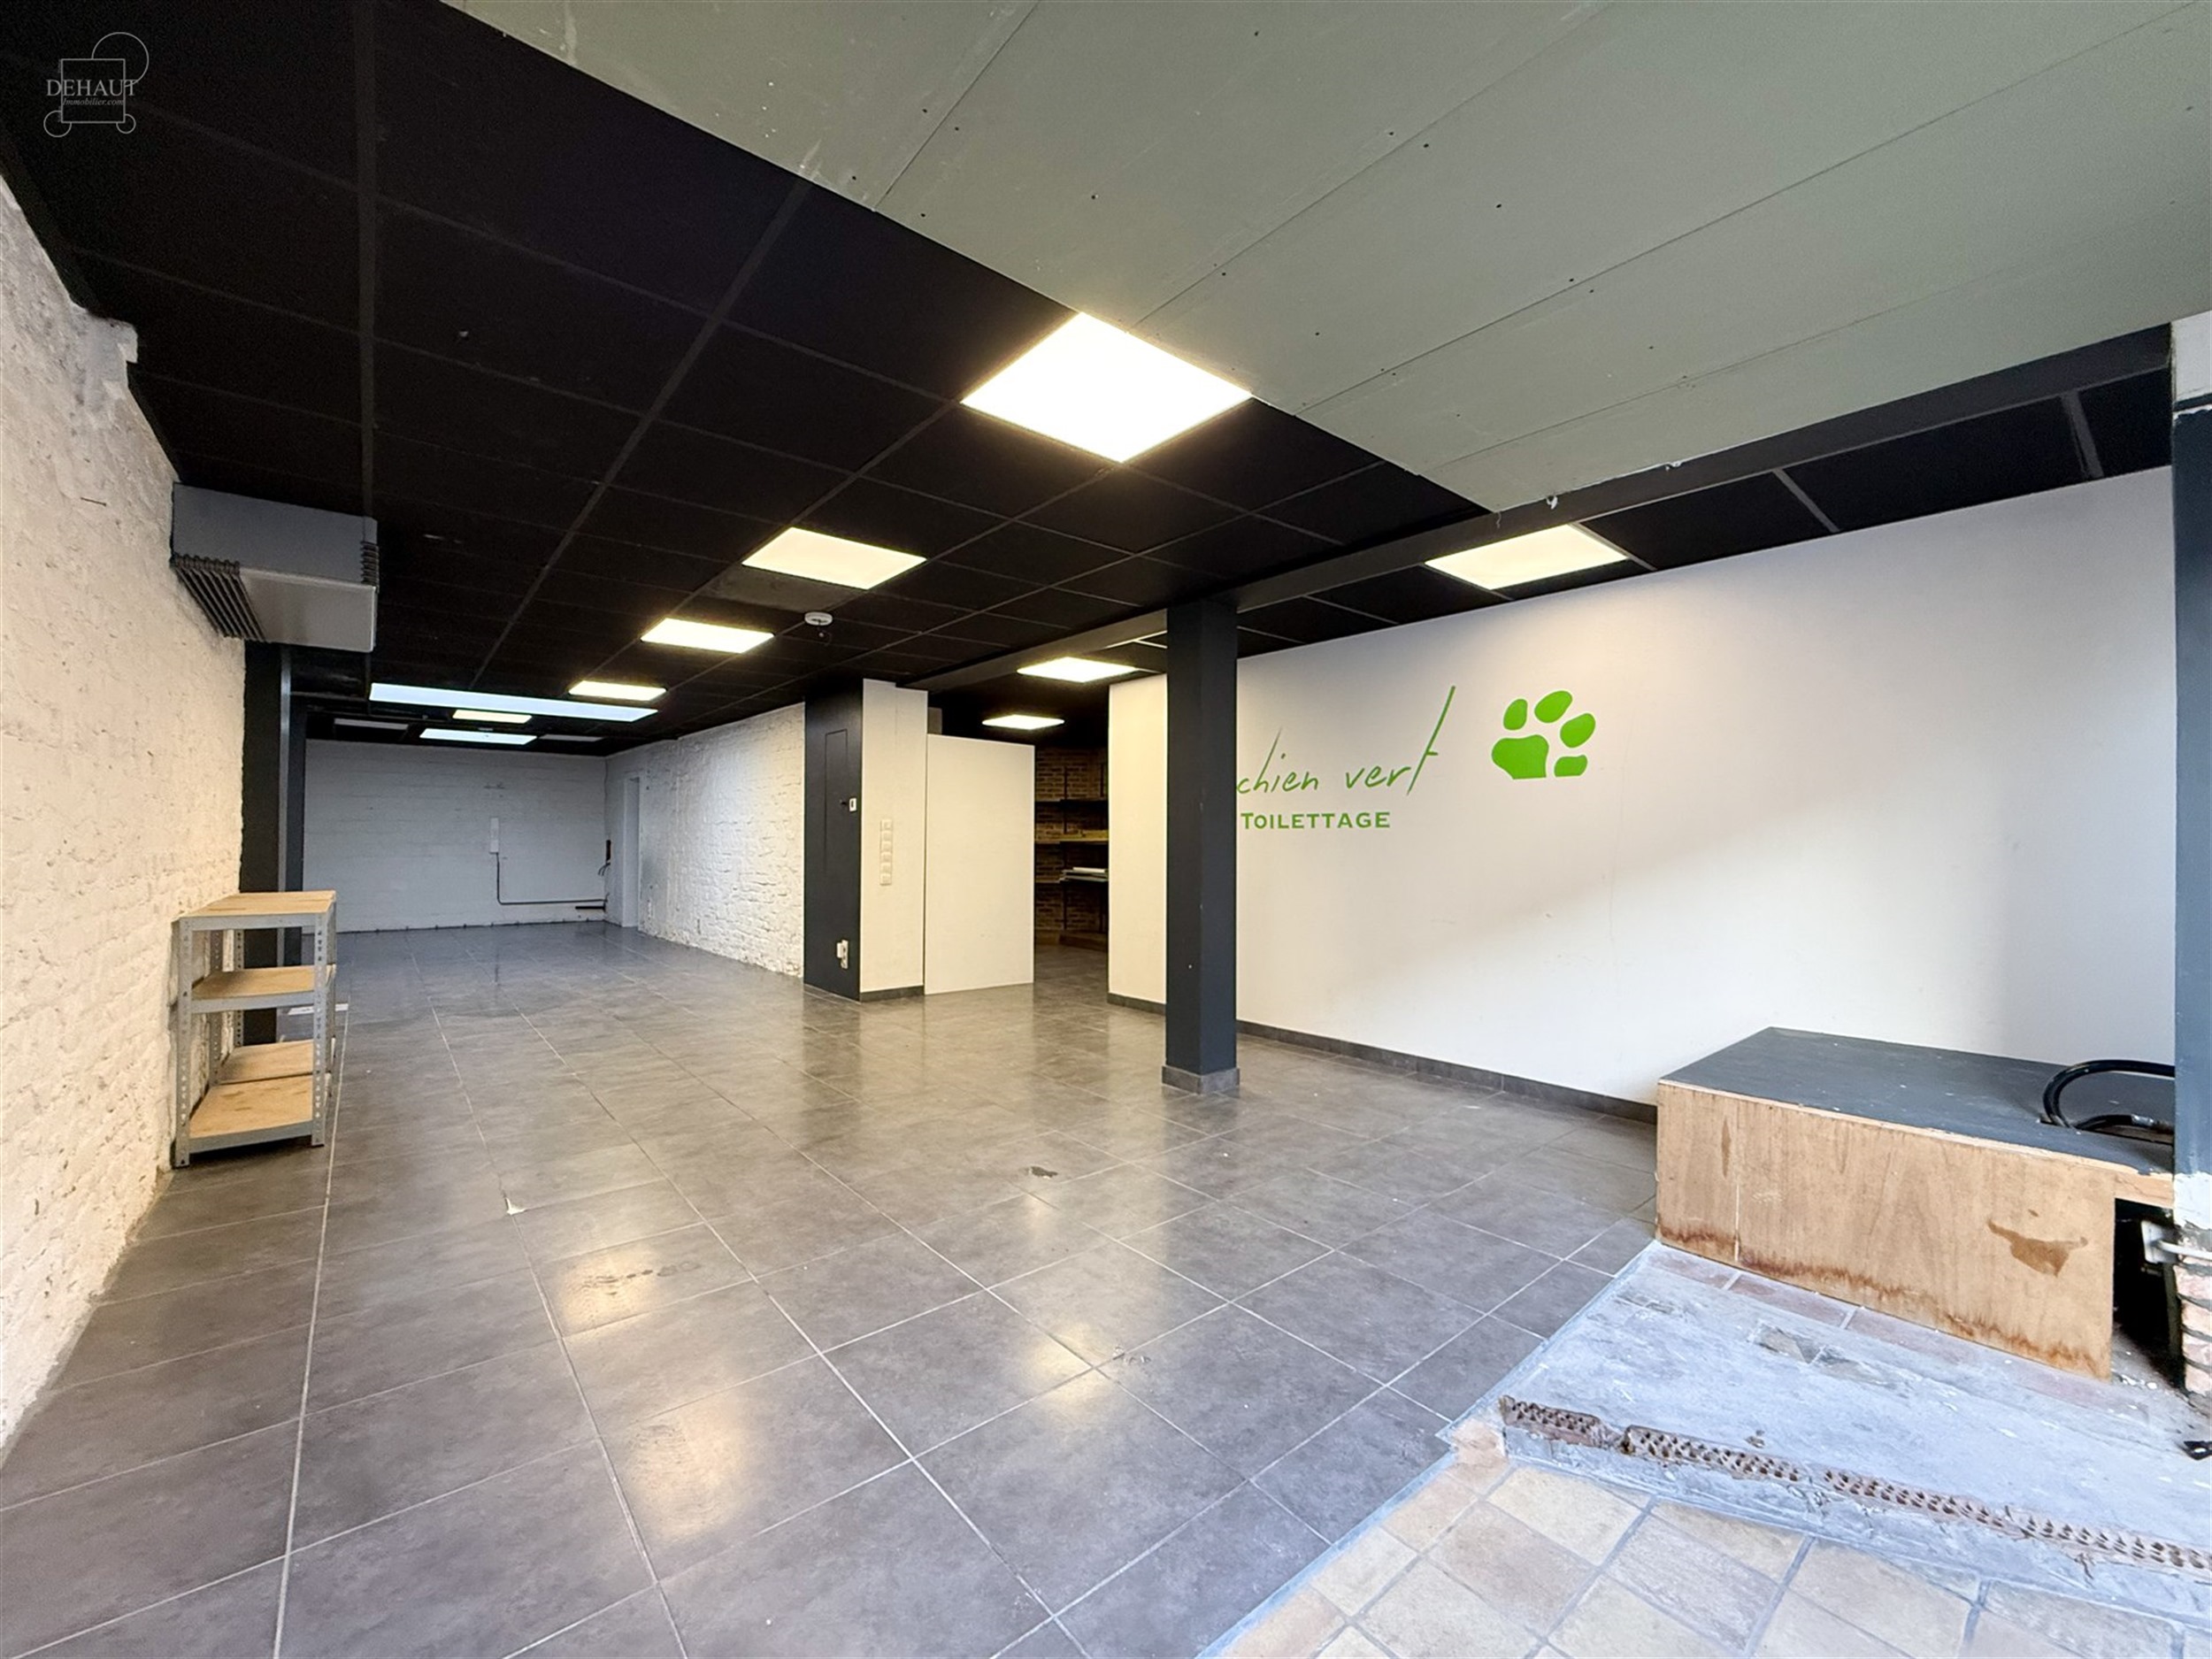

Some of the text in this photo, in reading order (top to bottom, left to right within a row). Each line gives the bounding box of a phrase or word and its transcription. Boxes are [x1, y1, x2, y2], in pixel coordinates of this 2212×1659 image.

[1237, 685, 1456, 796] chien vert
[1240, 812, 1391, 830] TOILETTAGE
